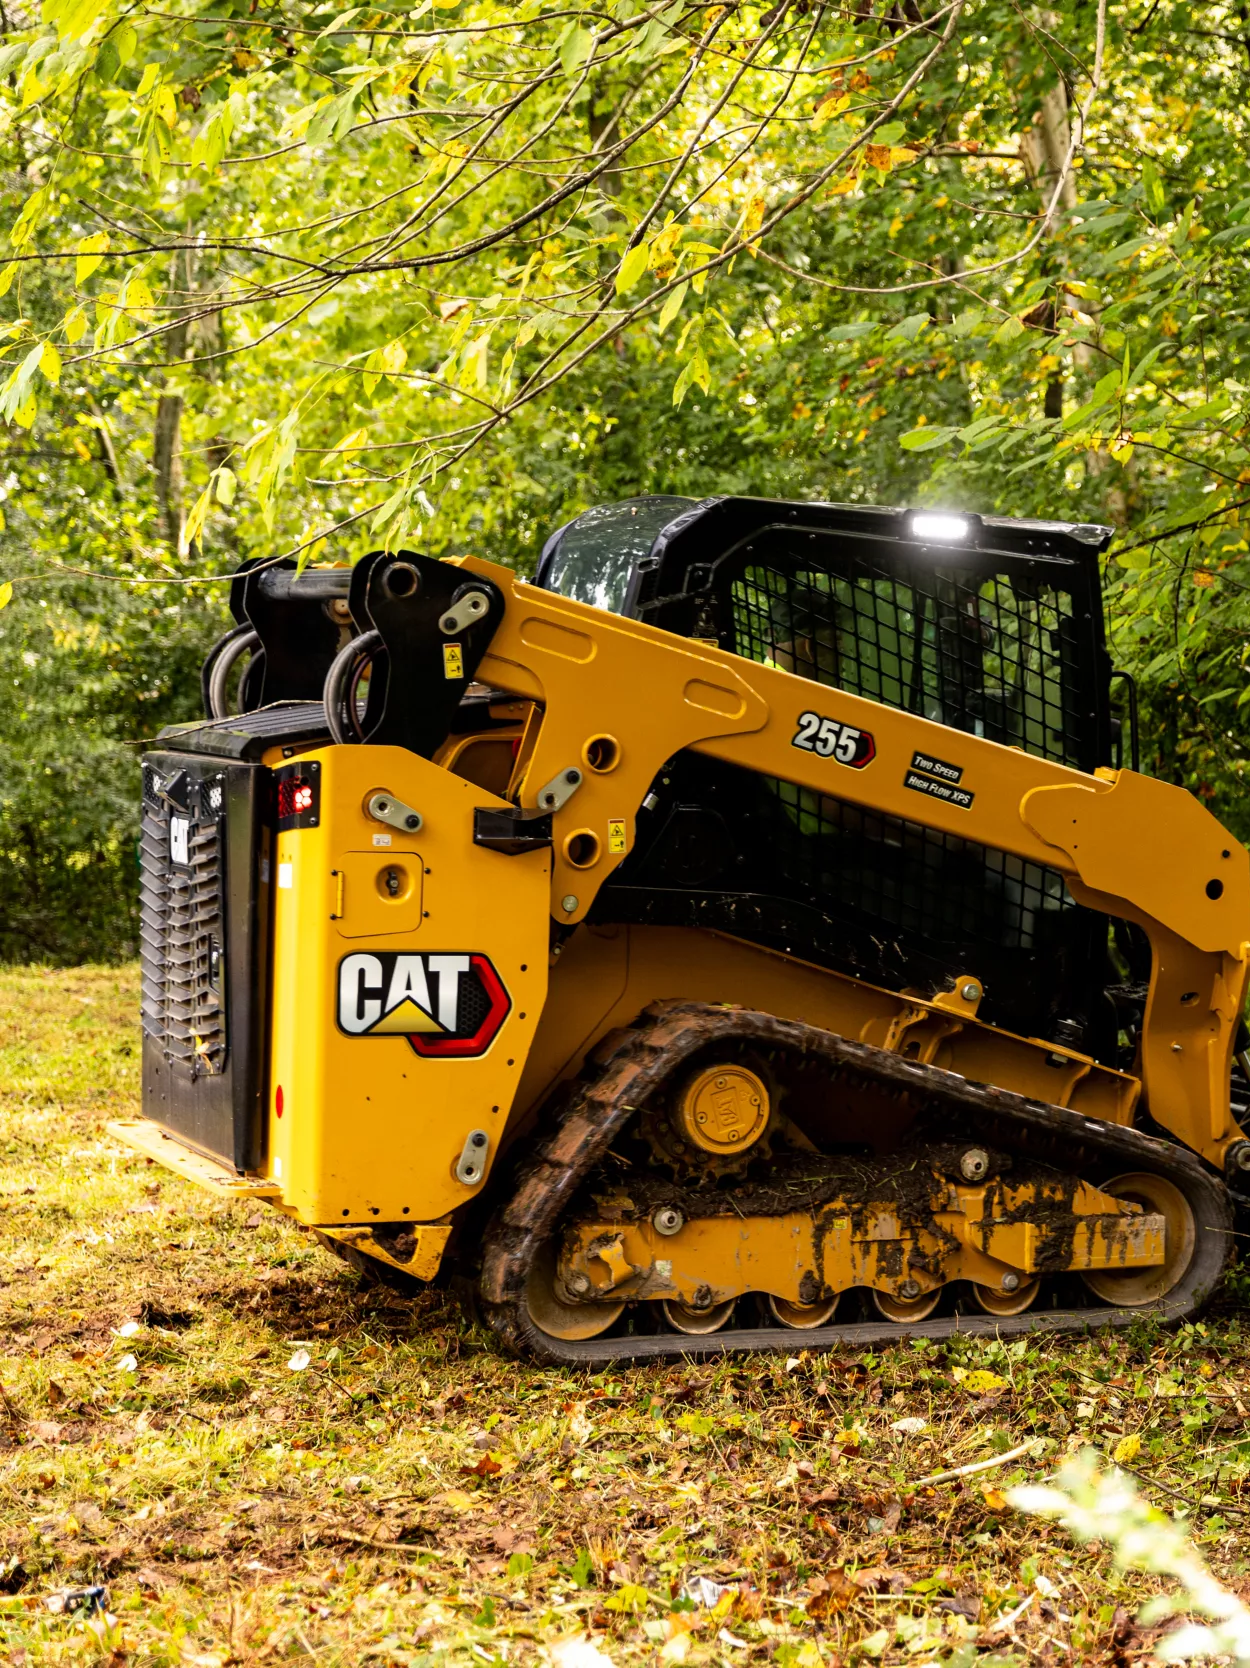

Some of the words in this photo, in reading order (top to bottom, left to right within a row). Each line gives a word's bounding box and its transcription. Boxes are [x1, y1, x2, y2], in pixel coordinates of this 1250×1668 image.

[793, 713, 861, 762] 255
[950, 790, 971, 804] XPS
[171, 816, 190, 864] CAT
[340, 953, 470, 1033] CAT
